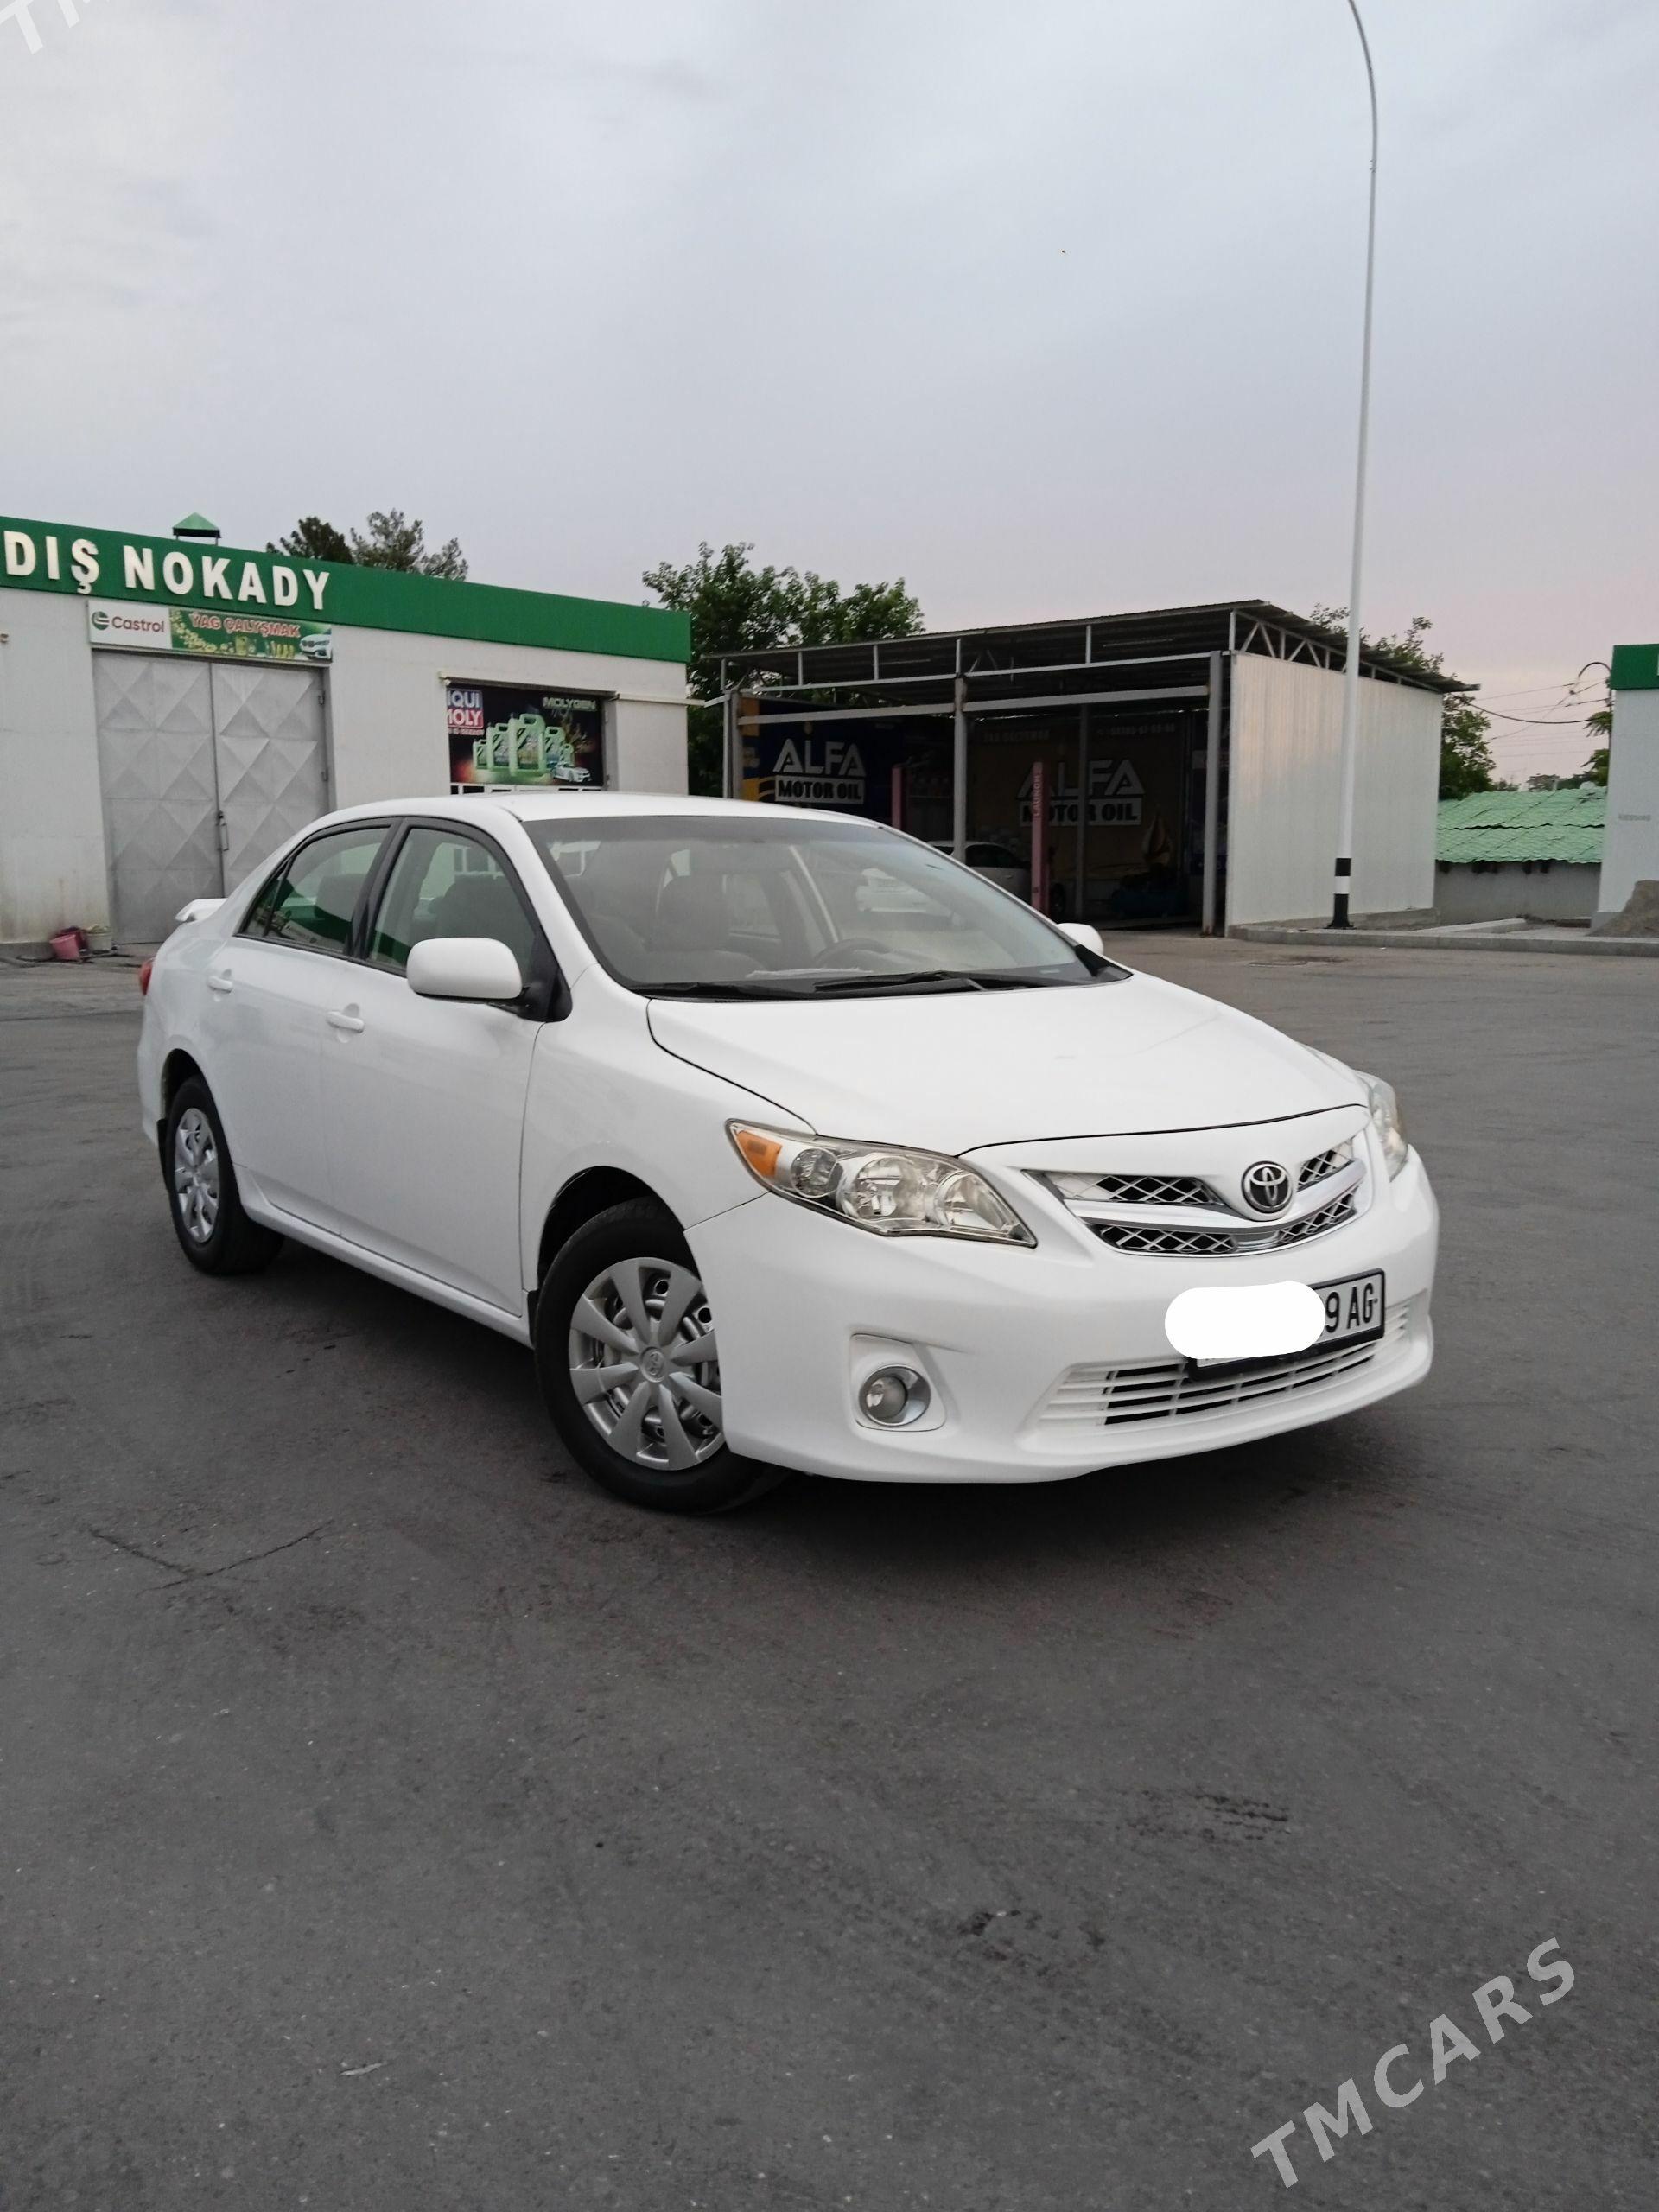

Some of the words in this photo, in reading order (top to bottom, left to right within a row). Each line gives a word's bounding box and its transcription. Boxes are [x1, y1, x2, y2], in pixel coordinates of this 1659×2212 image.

[3, 530, 100, 594] DIŞ
[123, 545, 330, 610] NOKADY
[112, 616, 164, 632] Castrol
[447, 690, 480, 708] IQUI
[772, 738, 866, 777] ALFA
[778, 779, 834, 798] MOTOR
[837, 782, 862, 800] OIL
[1102, 803, 1137, 822] OIL
[1346, 1282, 1374, 1329] AG
